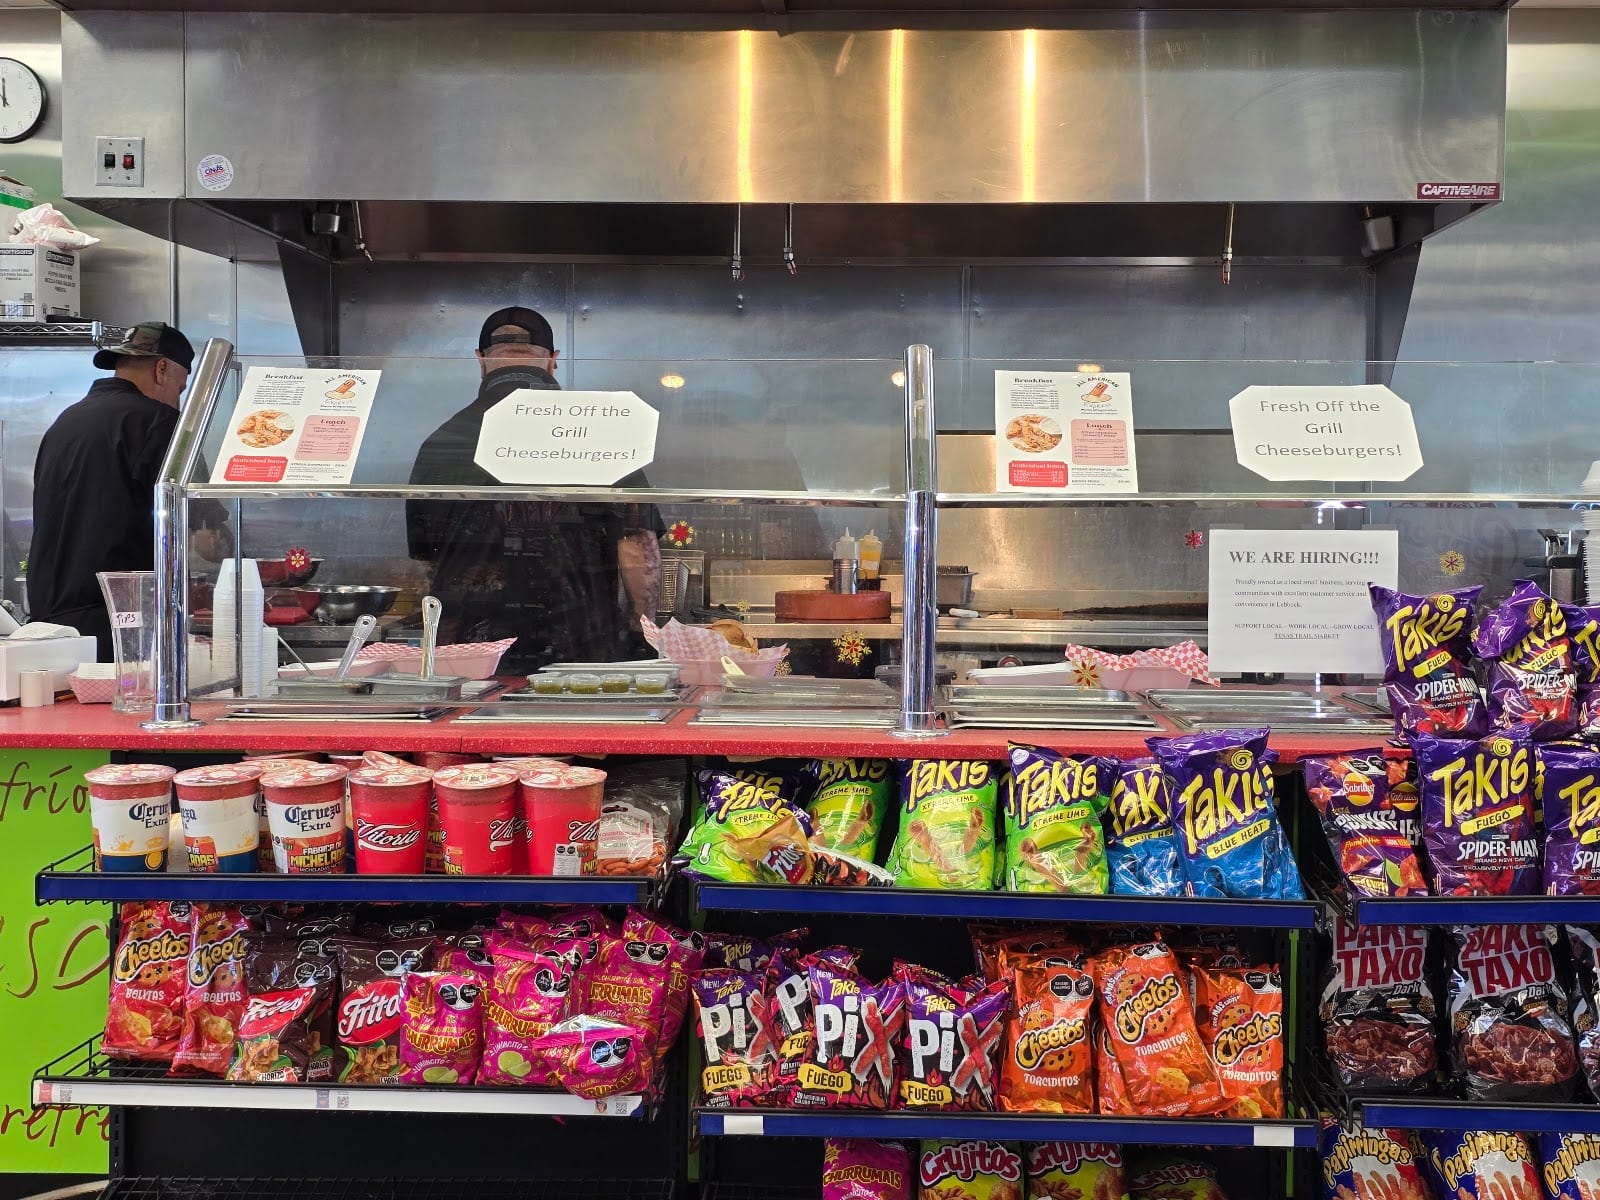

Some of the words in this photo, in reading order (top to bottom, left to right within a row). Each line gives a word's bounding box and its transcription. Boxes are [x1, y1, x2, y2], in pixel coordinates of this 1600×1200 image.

[515, 404, 562, 416] Fresh
[569, 405, 597, 417] Off
[602, 406, 631, 417] the
[1260, 400, 1309, 412] Fresh
[1315, 401, 1344, 412] Off
[1349, 401, 1380, 412] the
[551, 426, 588, 438] Grill
[1305, 422, 1343, 434] Grill
[495, 446, 636, 462] Cheeseburgers!
[1255, 444, 1402, 459] Cheeseburgers!
[1229, 551, 1256, 563] WE
[1261, 551, 1295, 564] ARE
[1300, 552, 1379, 565] HIRING!!!
[1387, 604, 1467, 672] Takis
[906, 760, 989, 811] Takis
[1016, 760, 1097, 826] Takis
[1432, 748, 1529, 827] Takis
[301, 822, 331, 832] Extra
[1033, 815, 1064, 828] XTREME
[1067, 809, 1086, 820] LIME
[1476, 811, 1512, 829] FUEGO
[1213, 838, 1238, 855] BLUE
[1241, 823, 1266, 842] HEAT
[115, 931, 190, 983] Cheetos
[722, 942, 752, 966] Takis
[1337, 947, 1424, 989] TAXO
[1461, 948, 1552, 995] TAXO
[126, 988, 164, 1000] BOLITAS
[203, 991, 241, 1002] BOLITAS
[830, 978, 860, 1000] Takis
[1393, 982, 1420, 995] Dark
[1527, 983, 1553, 998] Dark
[1117, 974, 1180, 1042] Cheetos
[1016, 1017, 1085, 1070] Cheetos
[1135, 1032, 1188, 1056] TORCIDITOS
[1214, 1013, 1282, 1067] Cheetos
[706, 1067, 742, 1087] FUEGO
[807, 1068, 844, 1088] FUEGO
[1023, 1073, 1078, 1087] TORCIDITOS
[1222, 1069, 1278, 1081] TORCIDITOS
[907, 1088, 944, 1102] FUEGO
[920, 1142, 1022, 1187] Crujitos
[823, 1165, 902, 1190] CHURRUMAIS
